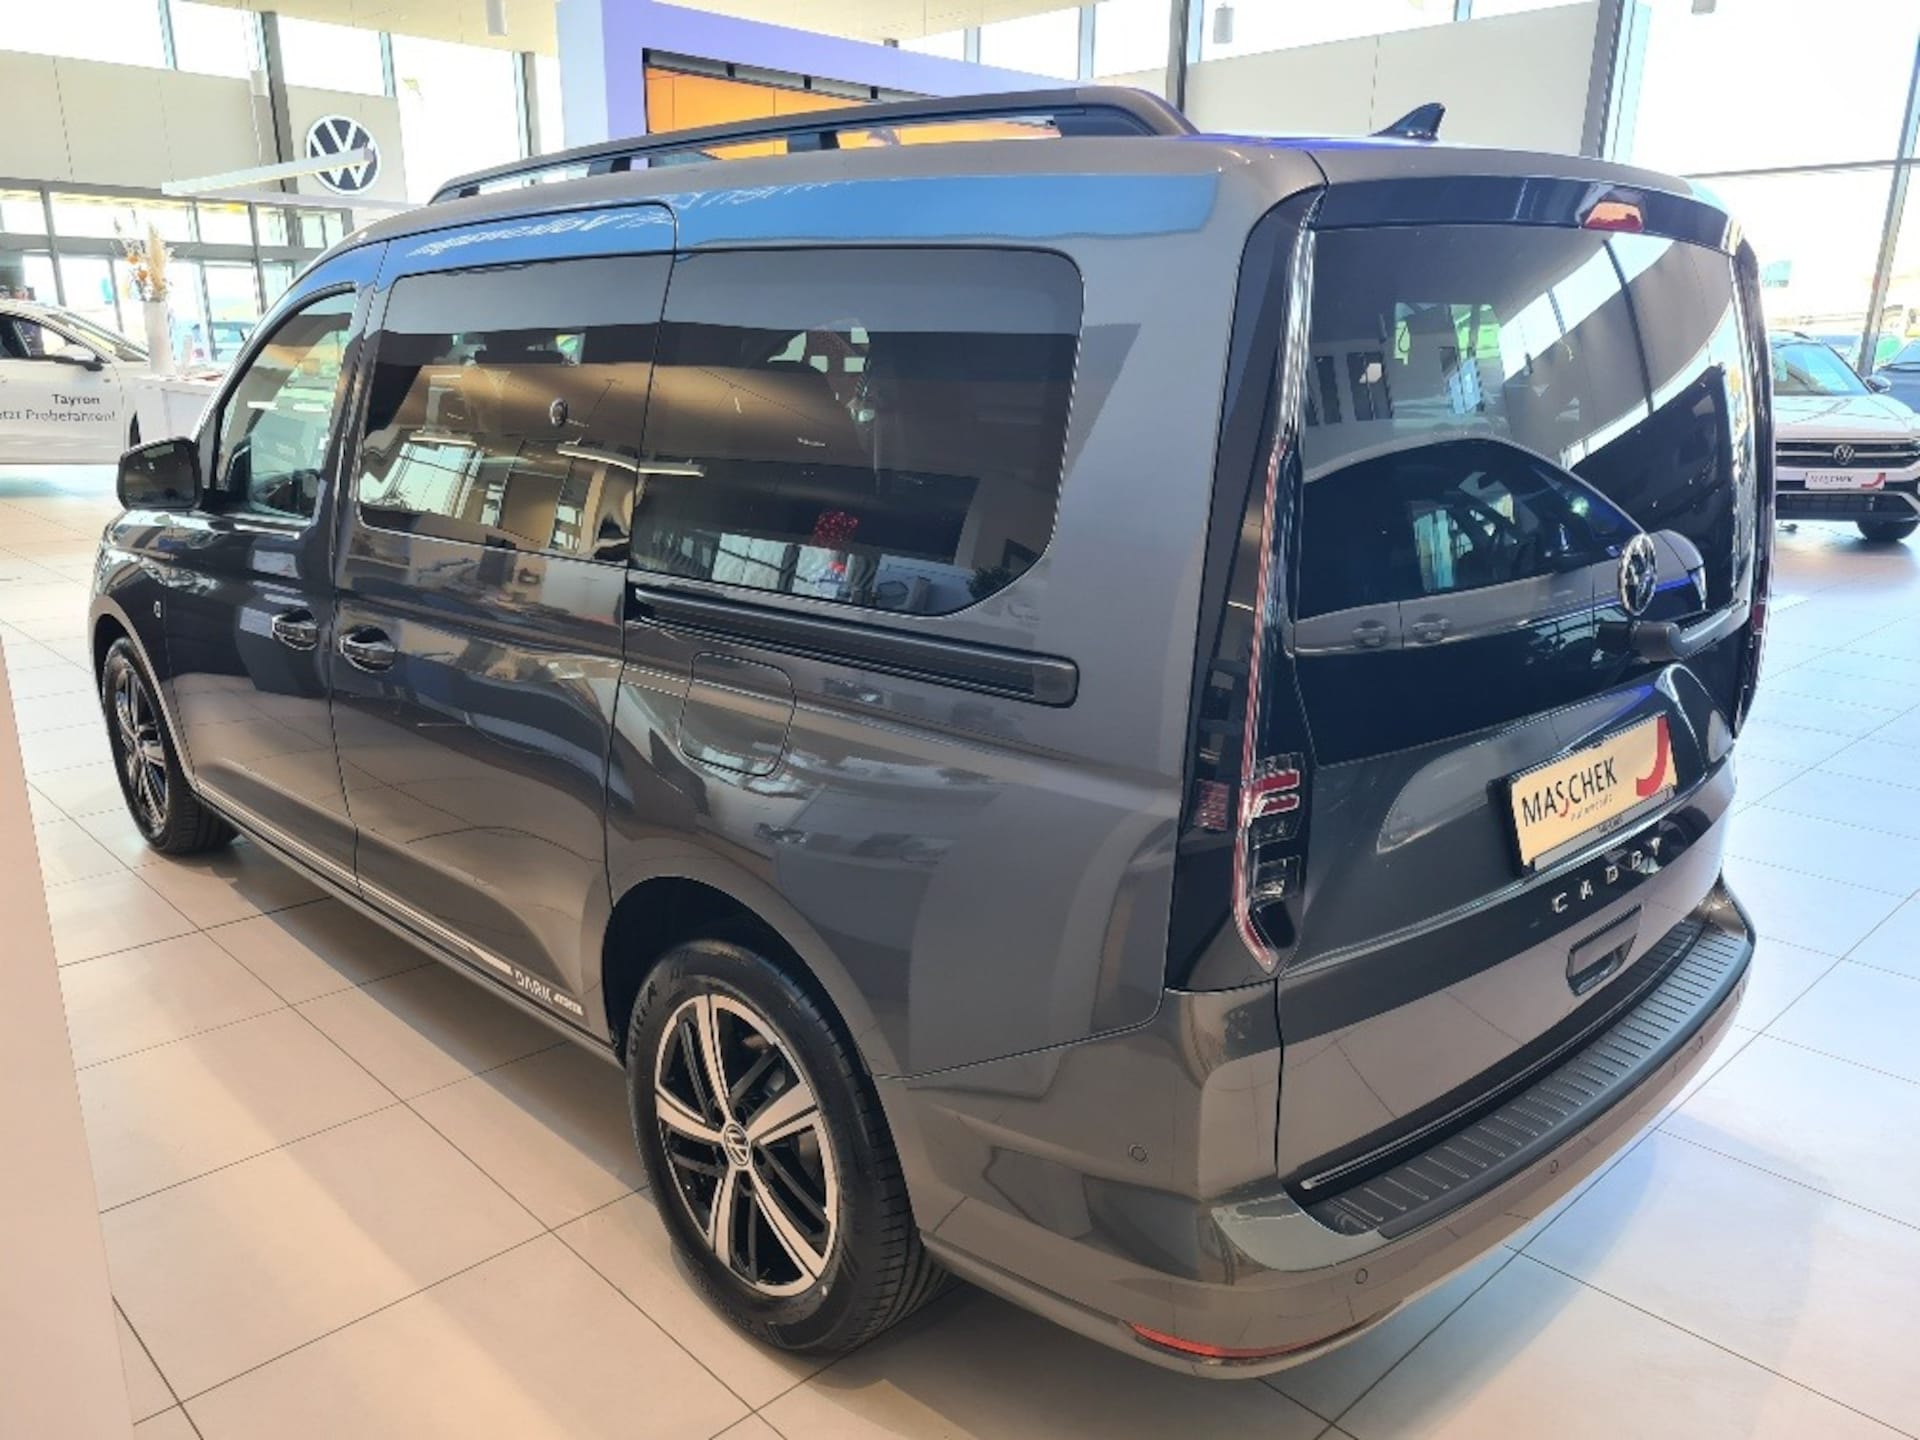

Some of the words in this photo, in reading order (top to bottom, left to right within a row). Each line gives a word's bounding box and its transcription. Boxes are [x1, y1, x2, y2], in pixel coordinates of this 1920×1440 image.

[52, 393, 100, 406] Tayron
[1521, 756, 1618, 827] MASCHEK
[1552, 837, 1662, 914] CADDY
[514, 969, 553, 1005] DARK
